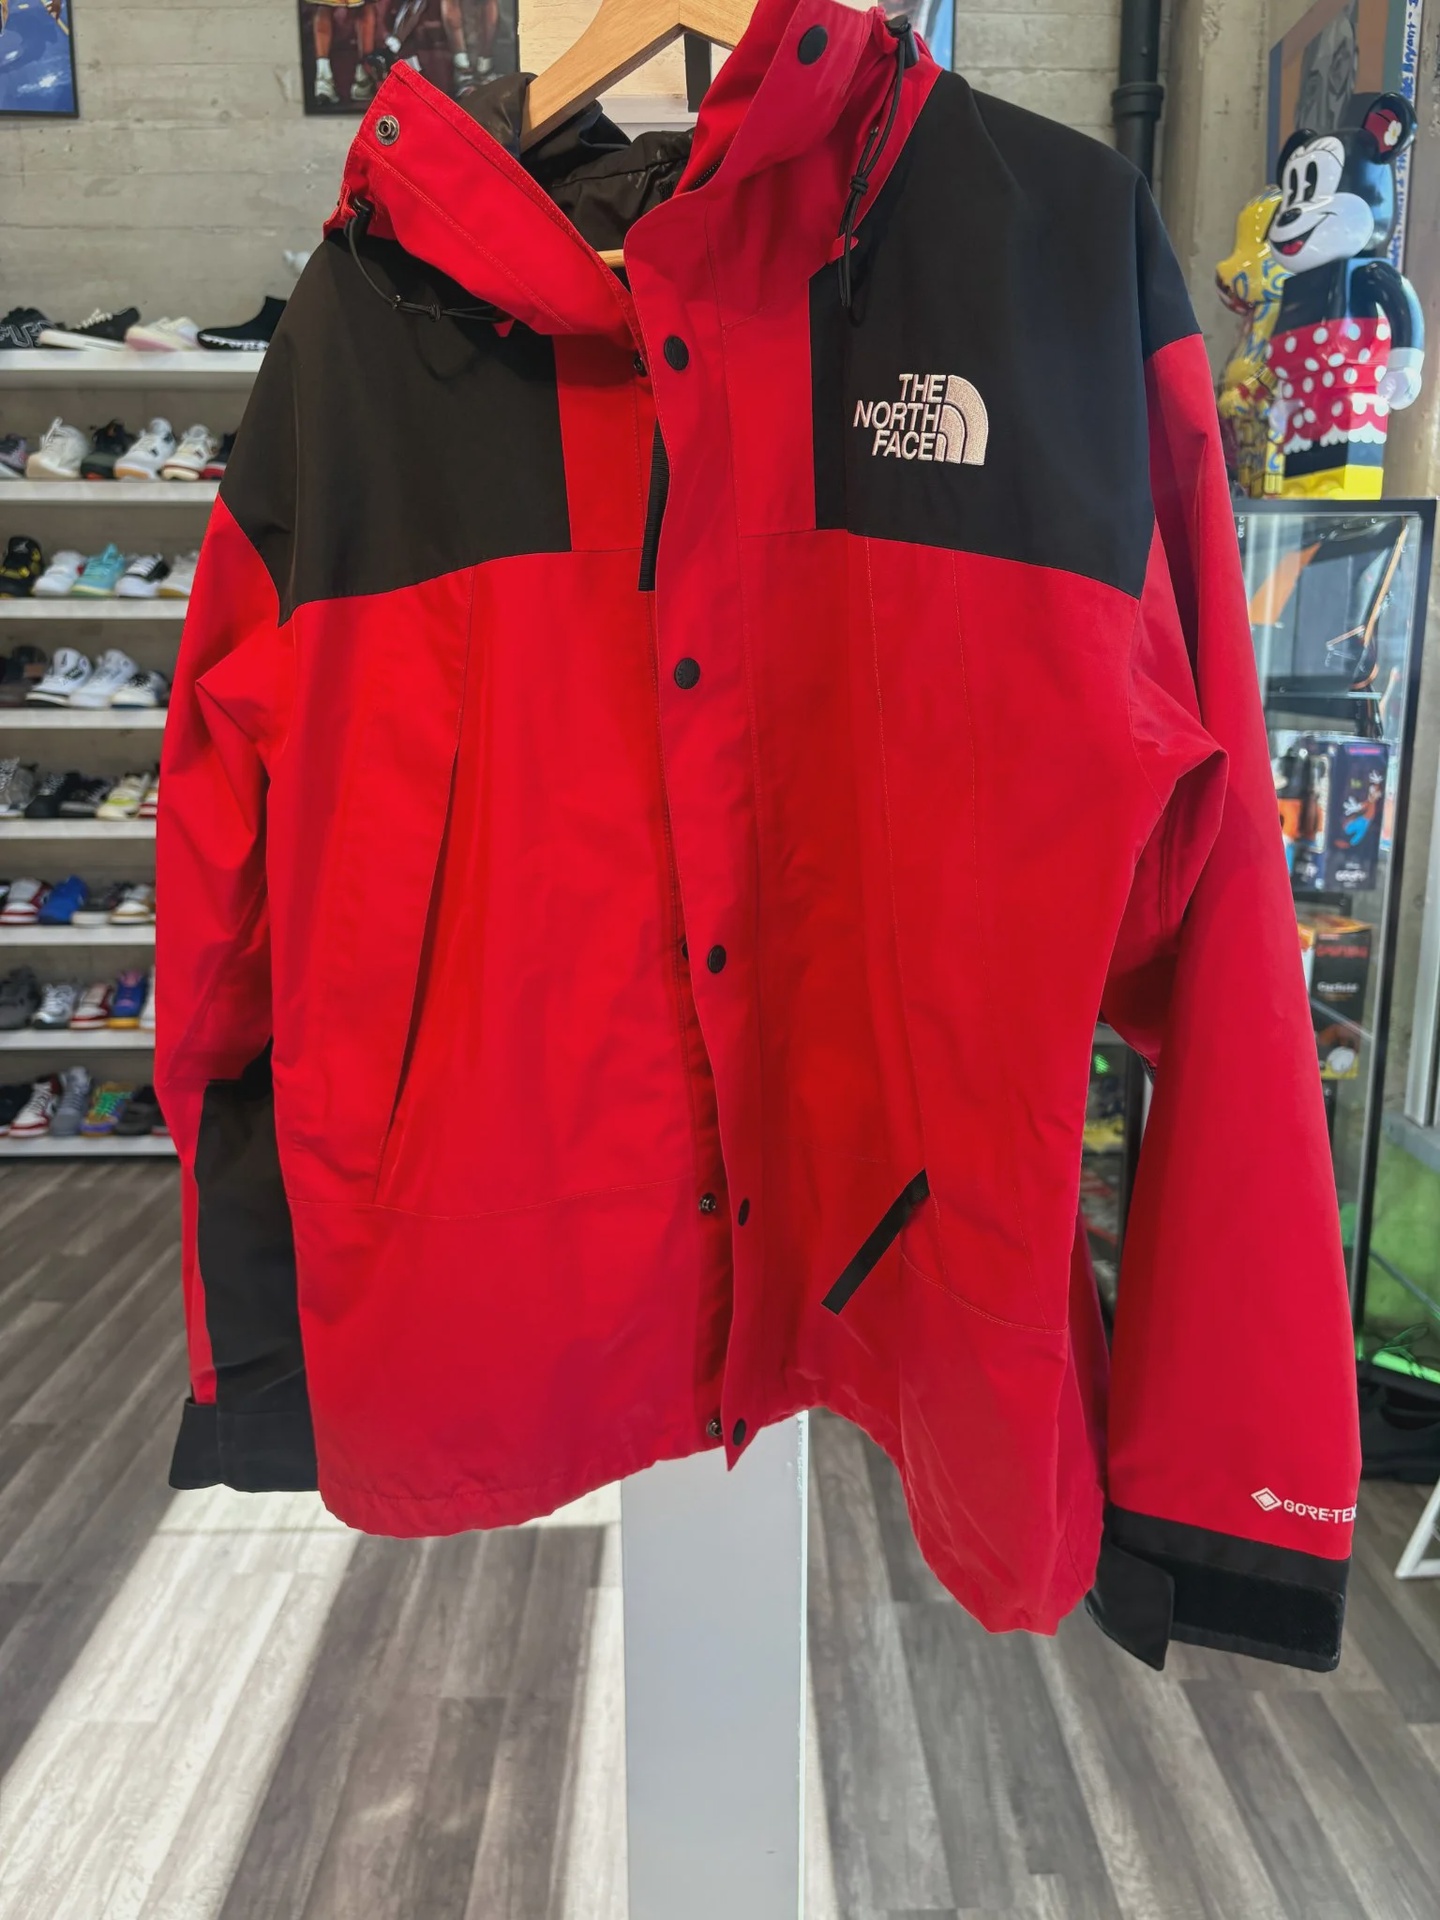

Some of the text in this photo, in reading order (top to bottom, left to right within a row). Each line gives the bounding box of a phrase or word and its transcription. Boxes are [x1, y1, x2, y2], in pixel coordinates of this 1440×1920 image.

[899, 374, 947, 403] THE
[853, 400, 941, 432] NORTH
[872, 430, 936, 461] FACE
